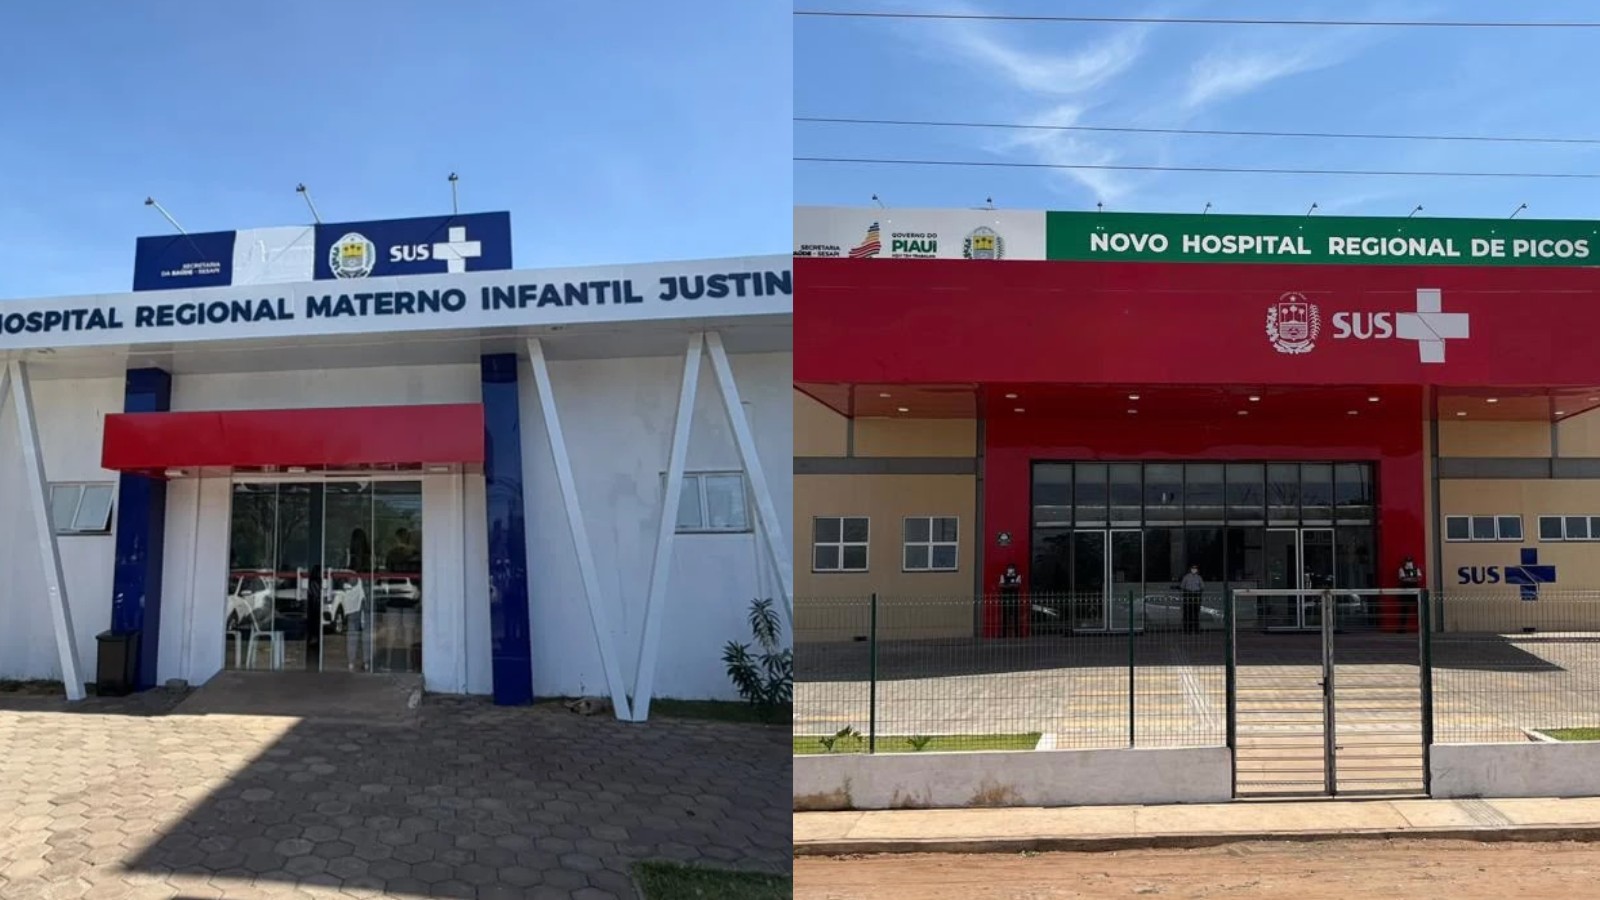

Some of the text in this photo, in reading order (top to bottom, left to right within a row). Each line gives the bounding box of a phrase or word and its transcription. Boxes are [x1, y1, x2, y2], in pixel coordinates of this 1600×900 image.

[389, 243, 430, 263] SUS
[1090, 233, 1590, 258] NOVO HOSPITAL REGIONAL DE PICOS
[0, 270, 792, 335] OSPITAL REGIONAL MATERNO INFANTIL JUSTIN
[1332, 311, 1393, 340] SUS
[1457, 565, 1500, 585] SUS
